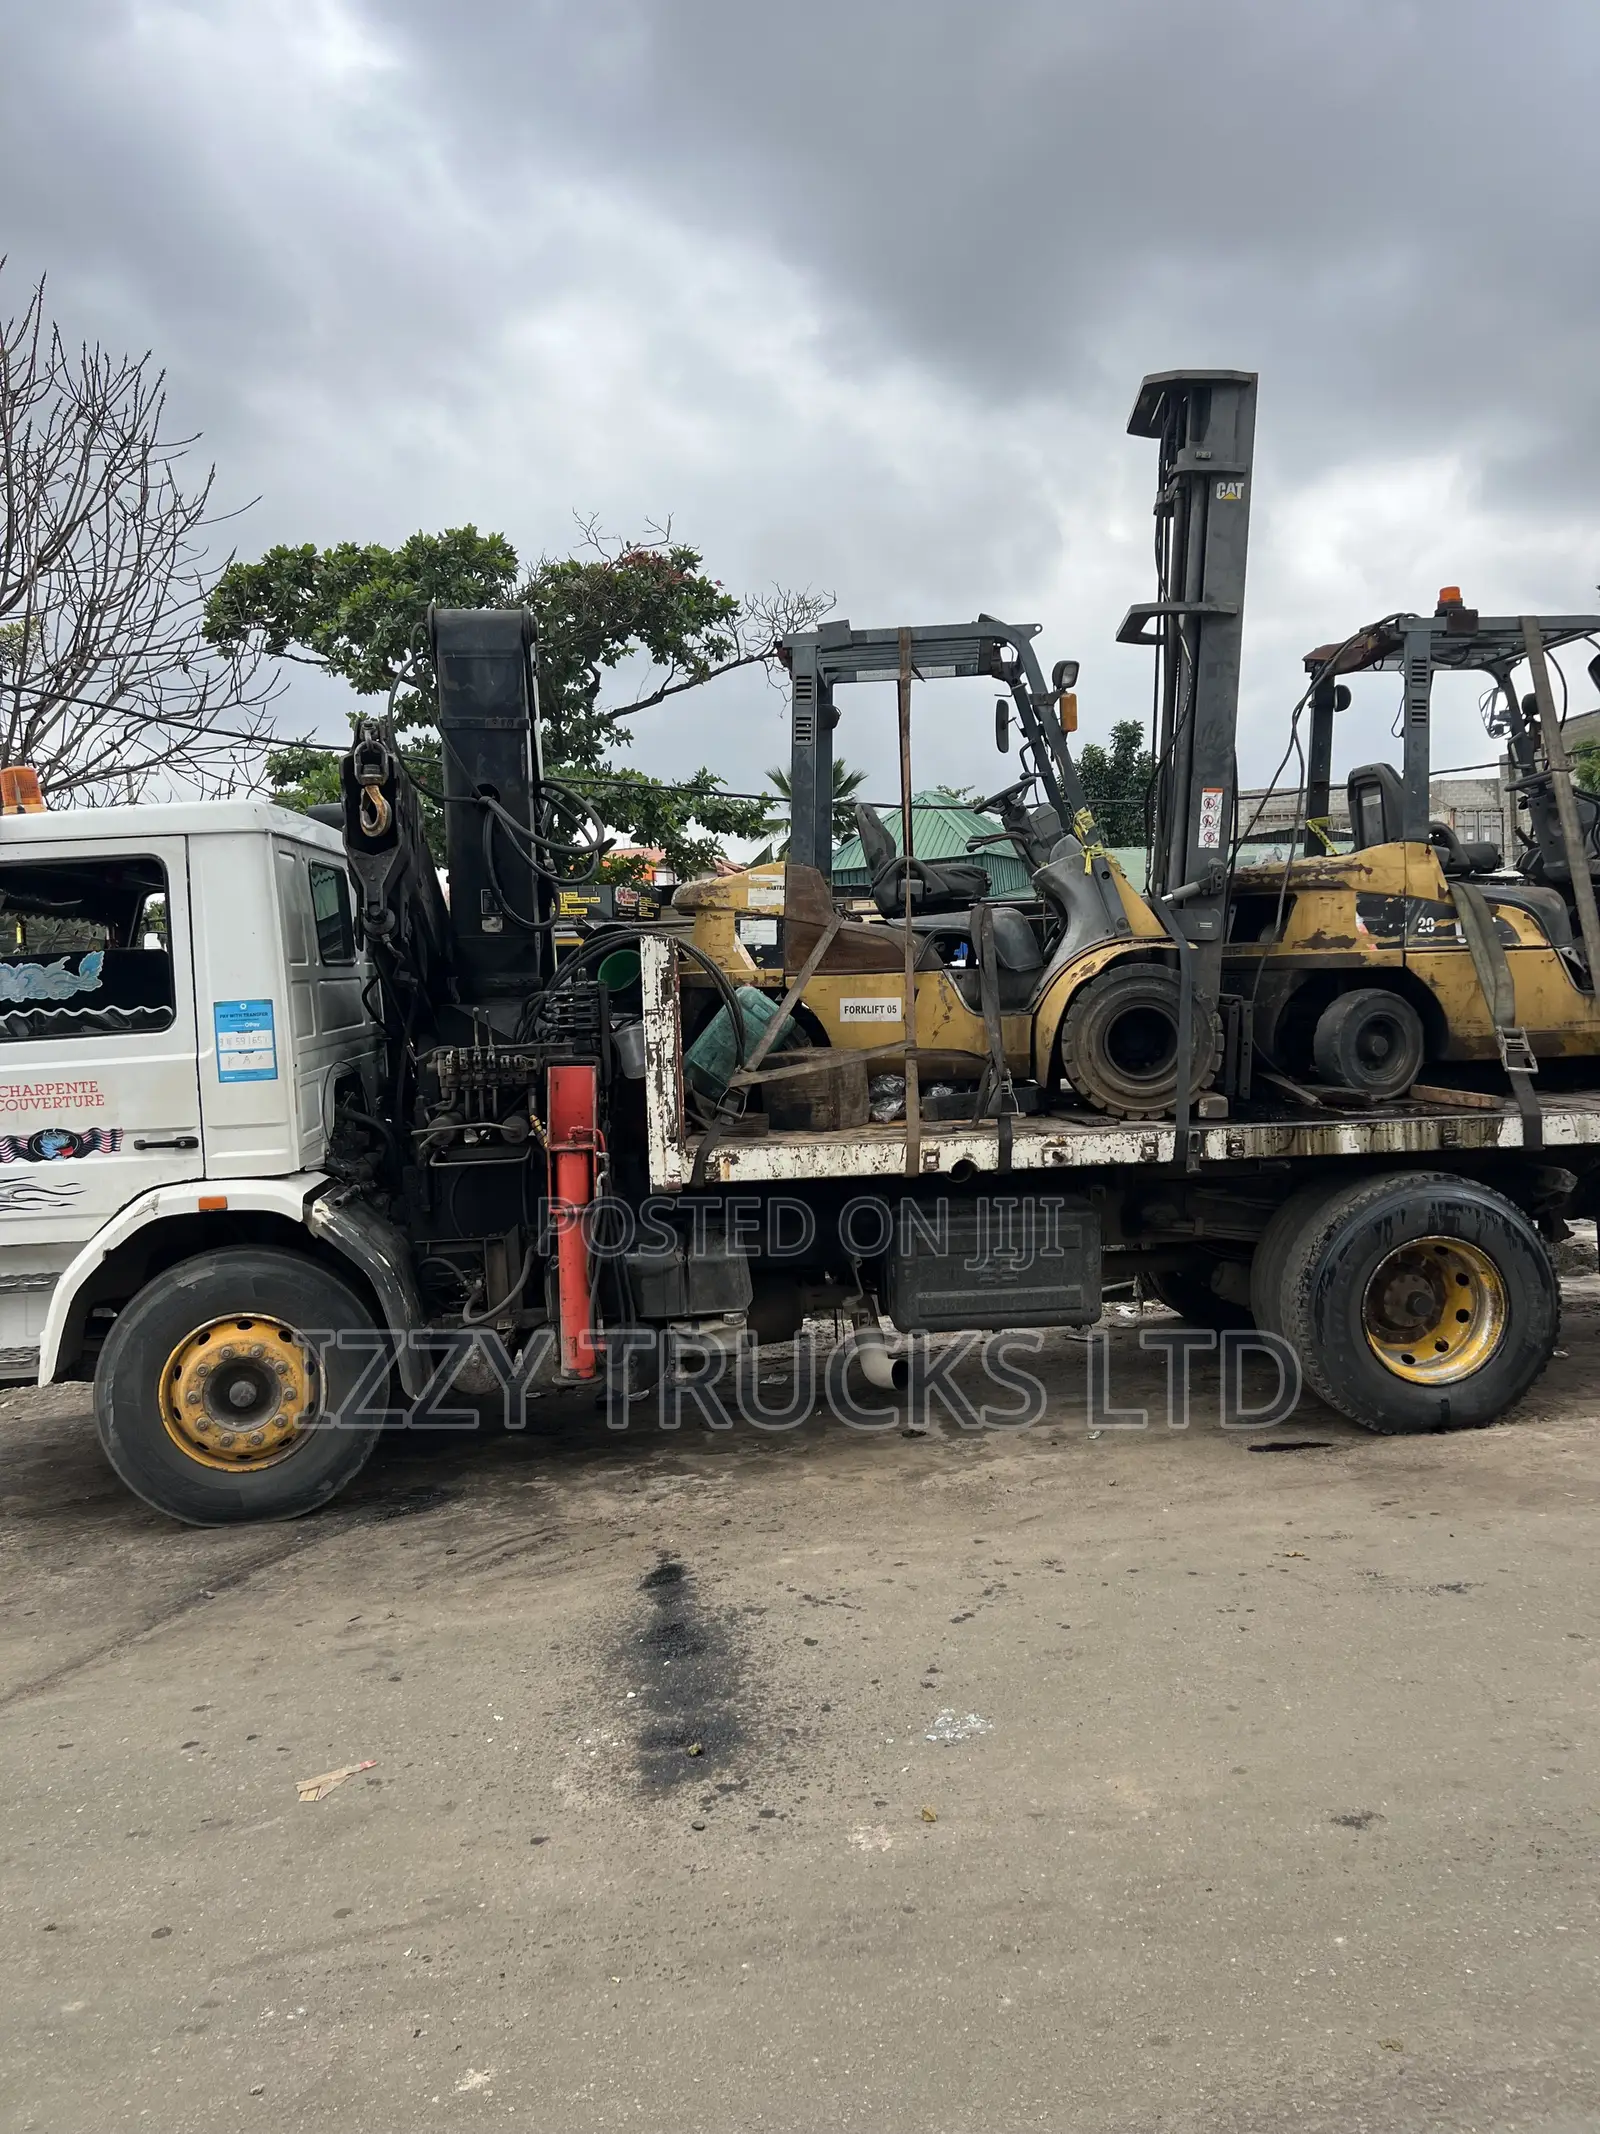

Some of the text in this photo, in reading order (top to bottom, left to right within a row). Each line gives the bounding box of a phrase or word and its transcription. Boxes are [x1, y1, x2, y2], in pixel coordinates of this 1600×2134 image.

[1216, 482, 1245, 500] CAT
[844, 1005, 897, 1015] FORKLIFT 05
[0, 1081, 99, 1098] CHARPENTE
